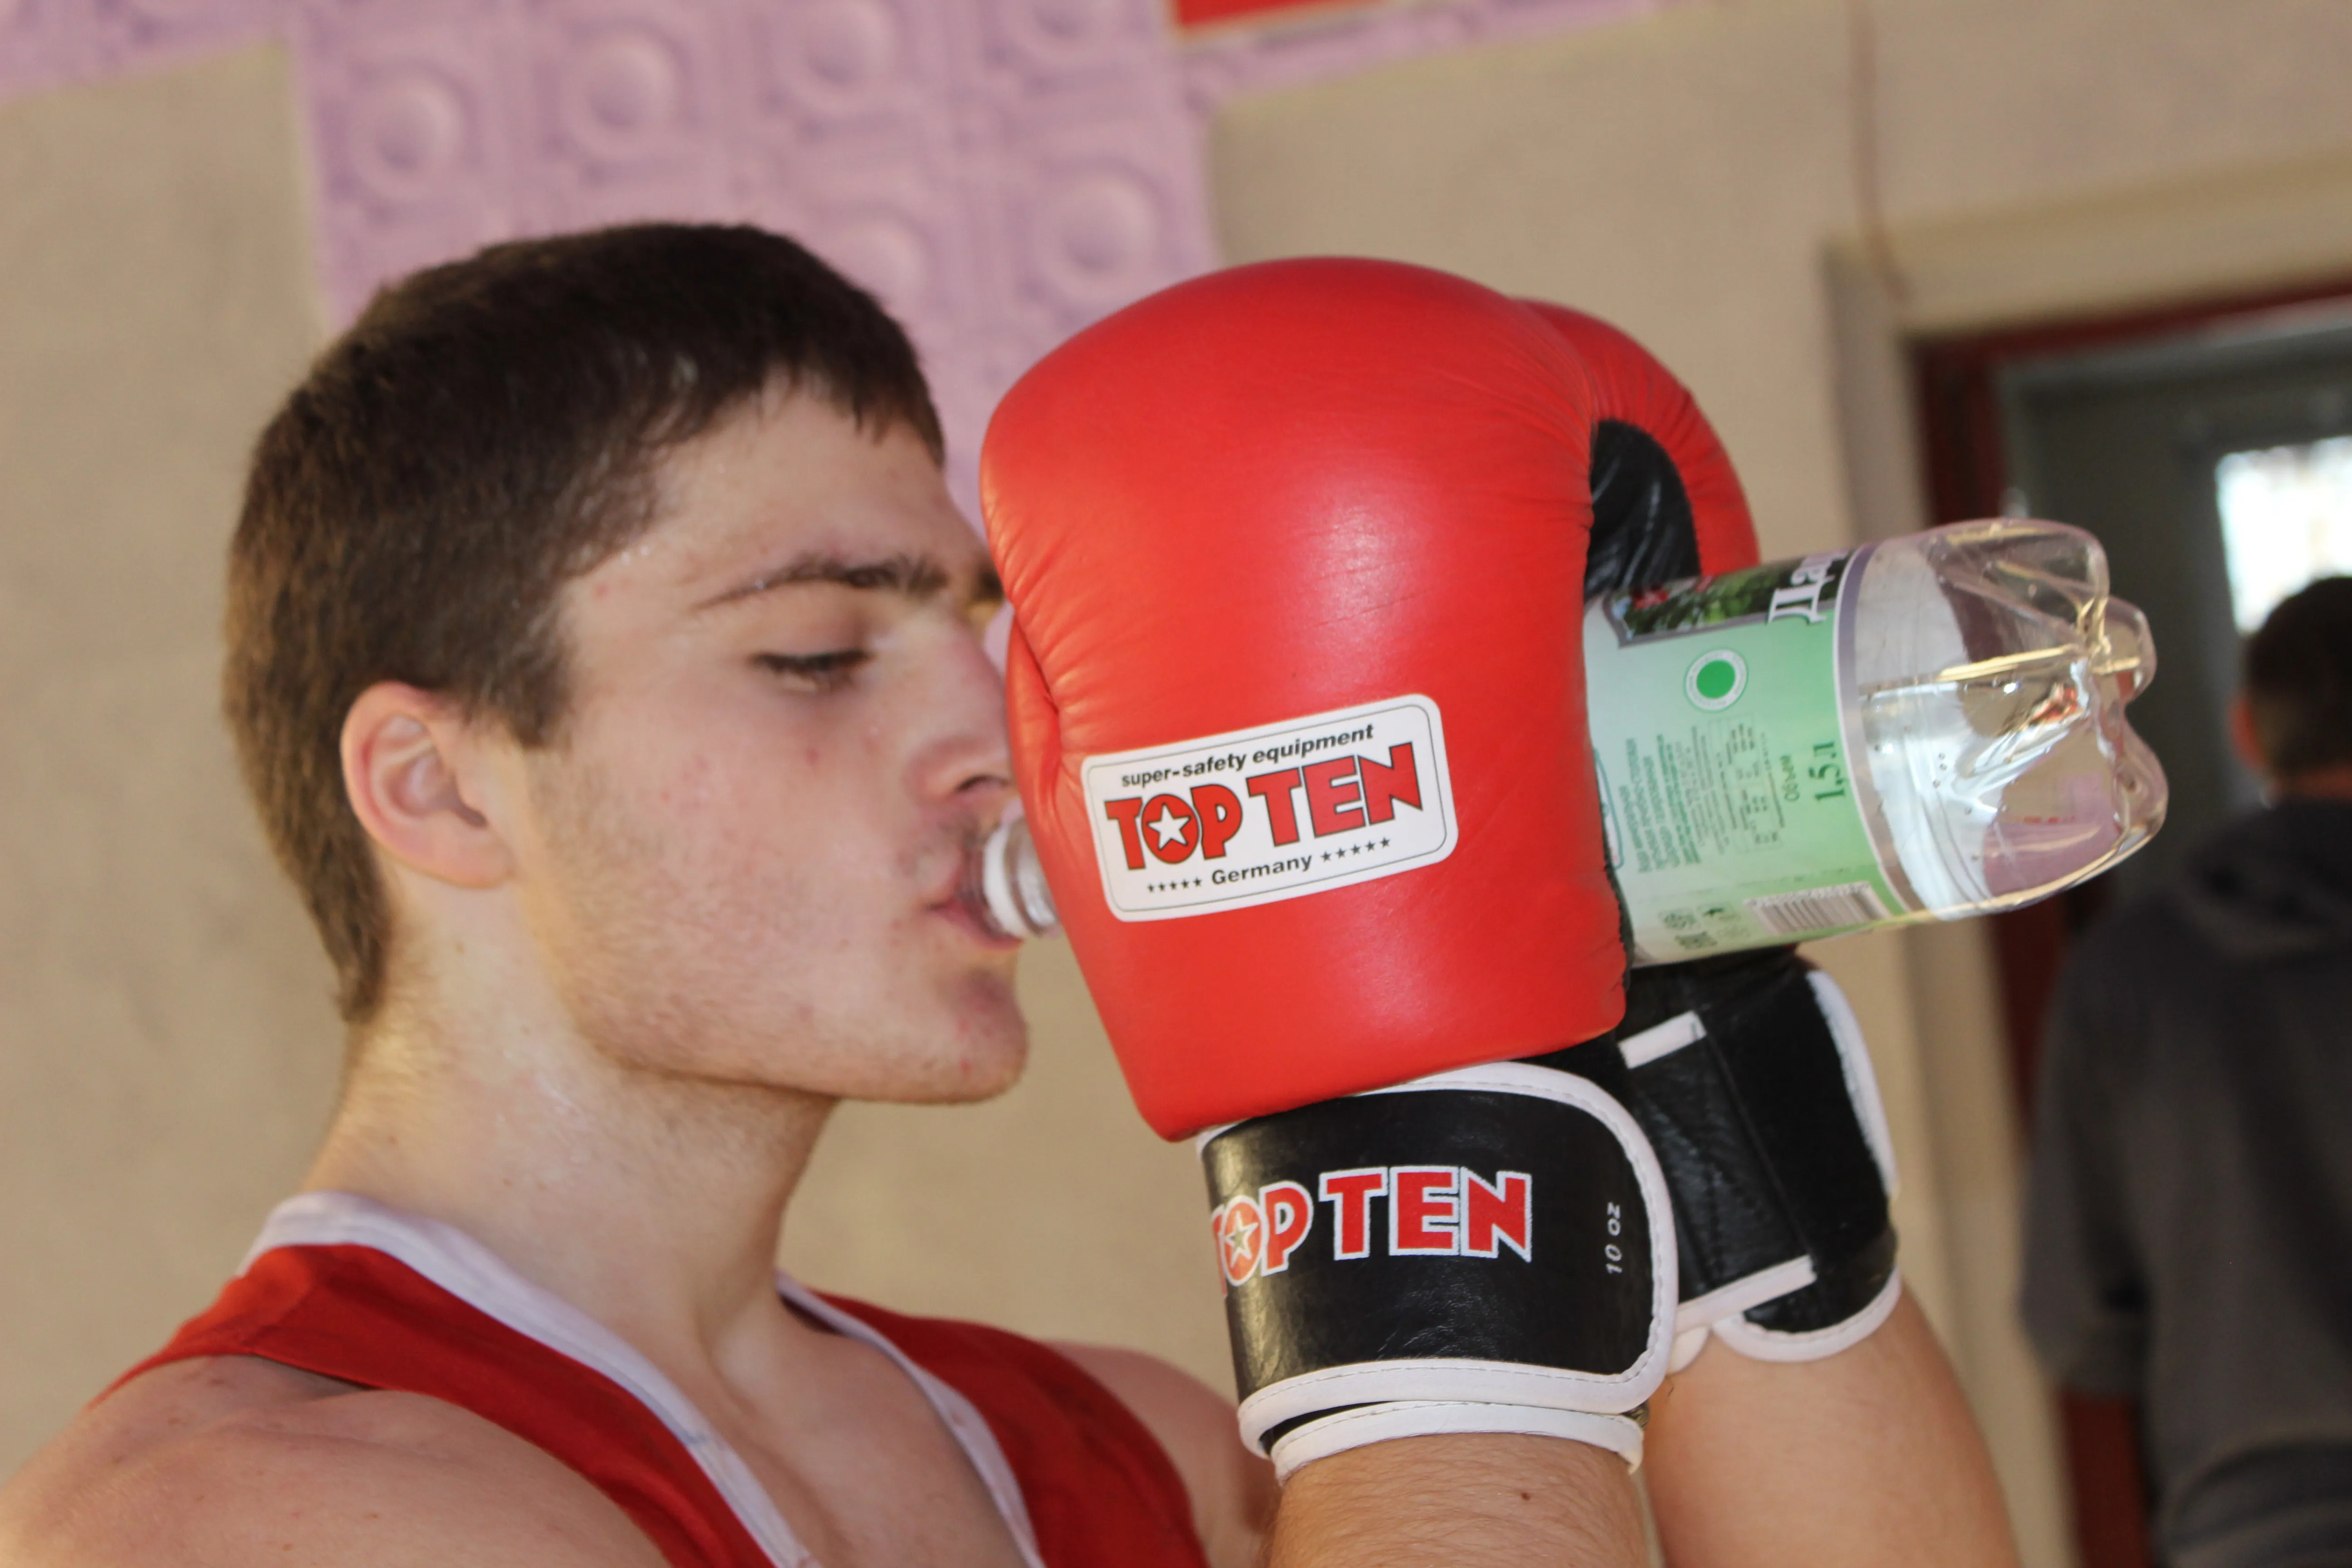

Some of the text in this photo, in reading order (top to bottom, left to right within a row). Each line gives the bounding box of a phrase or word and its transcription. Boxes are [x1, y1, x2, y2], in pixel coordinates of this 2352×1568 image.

[1122, 724, 1374, 788] super-safety equipment
[1104, 741, 1423, 871] TOP TEN
[1211, 853, 1313, 886] Germany
[1319, 1165, 1532, 1263] TEN
[1605, 1202, 1622, 1274] 10 oz
